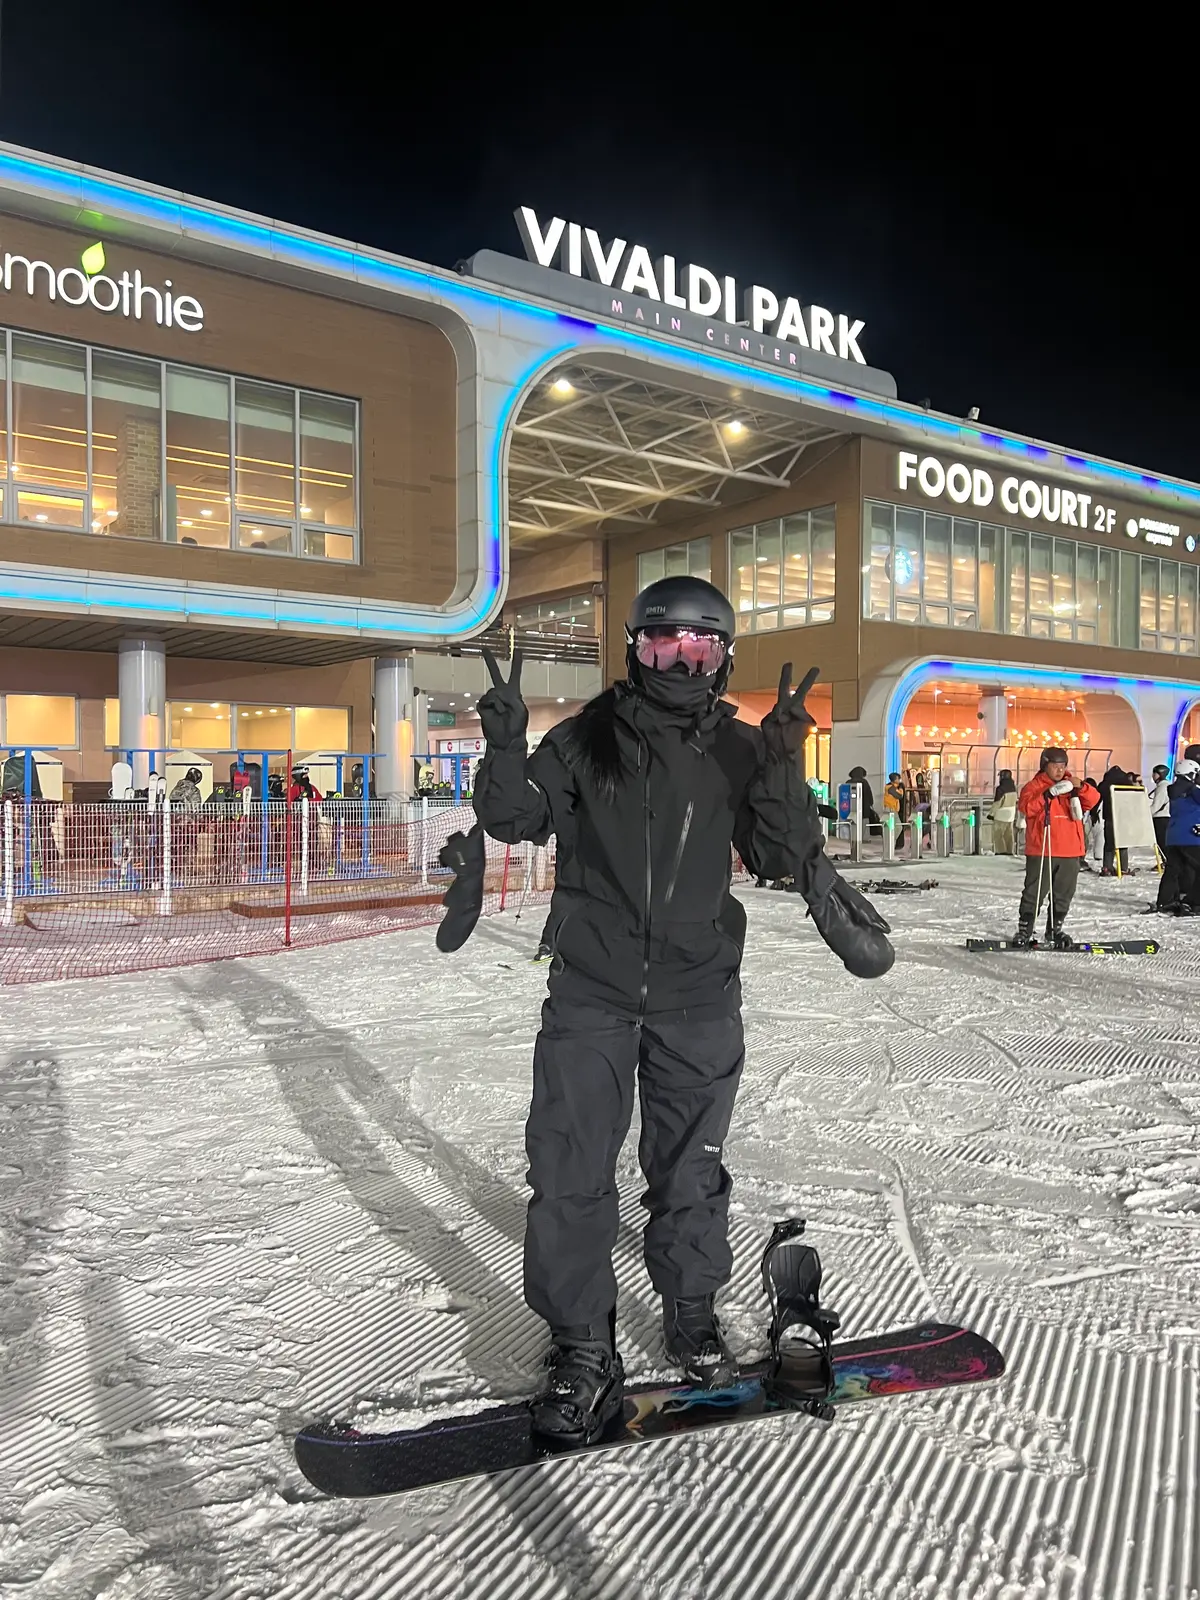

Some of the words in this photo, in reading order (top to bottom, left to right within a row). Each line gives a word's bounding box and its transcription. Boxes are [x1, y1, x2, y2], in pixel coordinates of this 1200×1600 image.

[0, 252, 204, 332] moothie
[515, 205, 738, 325] VIVALDI
[751, 285, 868, 365] PARK
[611, 299, 682, 331] MAIN
[705, 327, 797, 366] CENTER
[898, 450, 995, 507] FOOD
[1000, 475, 1092, 529] COURT
[1094, 505, 1117, 534] 2F
[645, 606, 666, 614] SMITH
